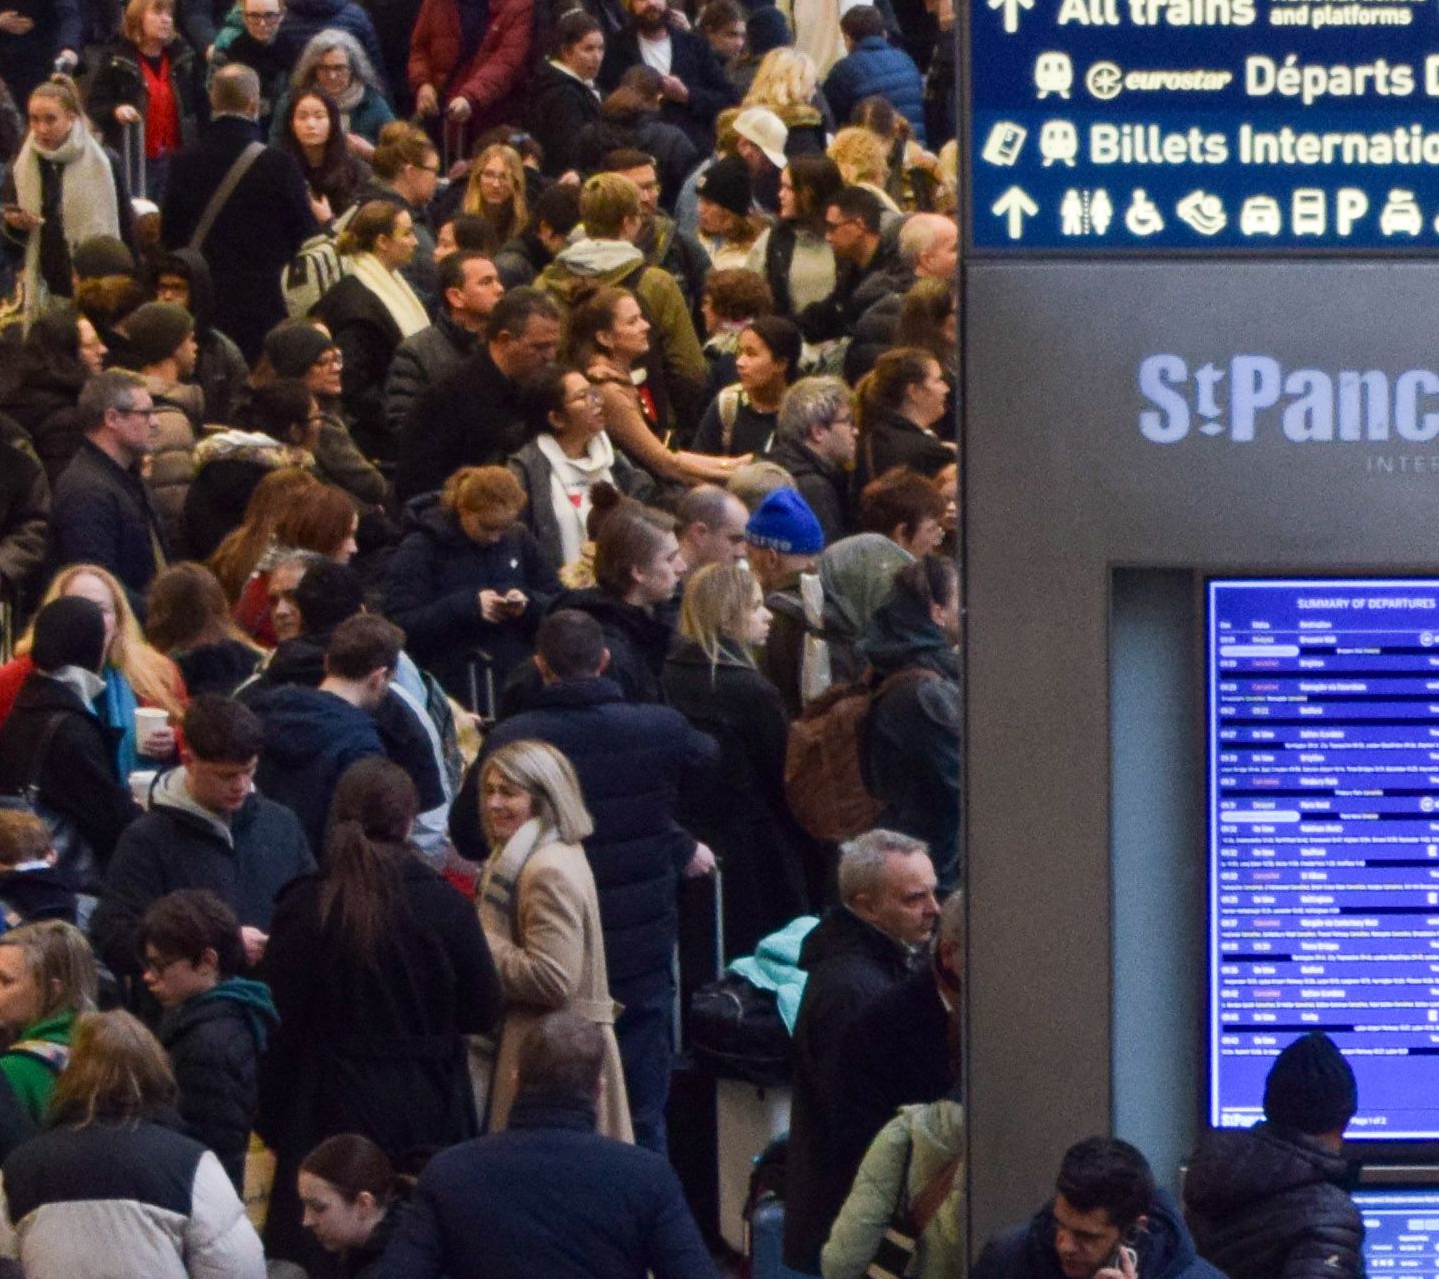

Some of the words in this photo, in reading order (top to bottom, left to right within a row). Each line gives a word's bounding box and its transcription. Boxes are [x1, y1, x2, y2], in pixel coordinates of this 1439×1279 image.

[1270, 5, 1307, 25] and
[1311, 4, 1412, 29] platforms
[1124, 70, 1232, 90] eurostar
[1246, 54, 1414, 105] Départs
[1090, 124, 1228, 164] Billets
[1297, 599, 1349, 609] SUMMARY
[1351, 598, 1365, 609] OF
[1368, 598, 1436, 609] DEPARTURES
